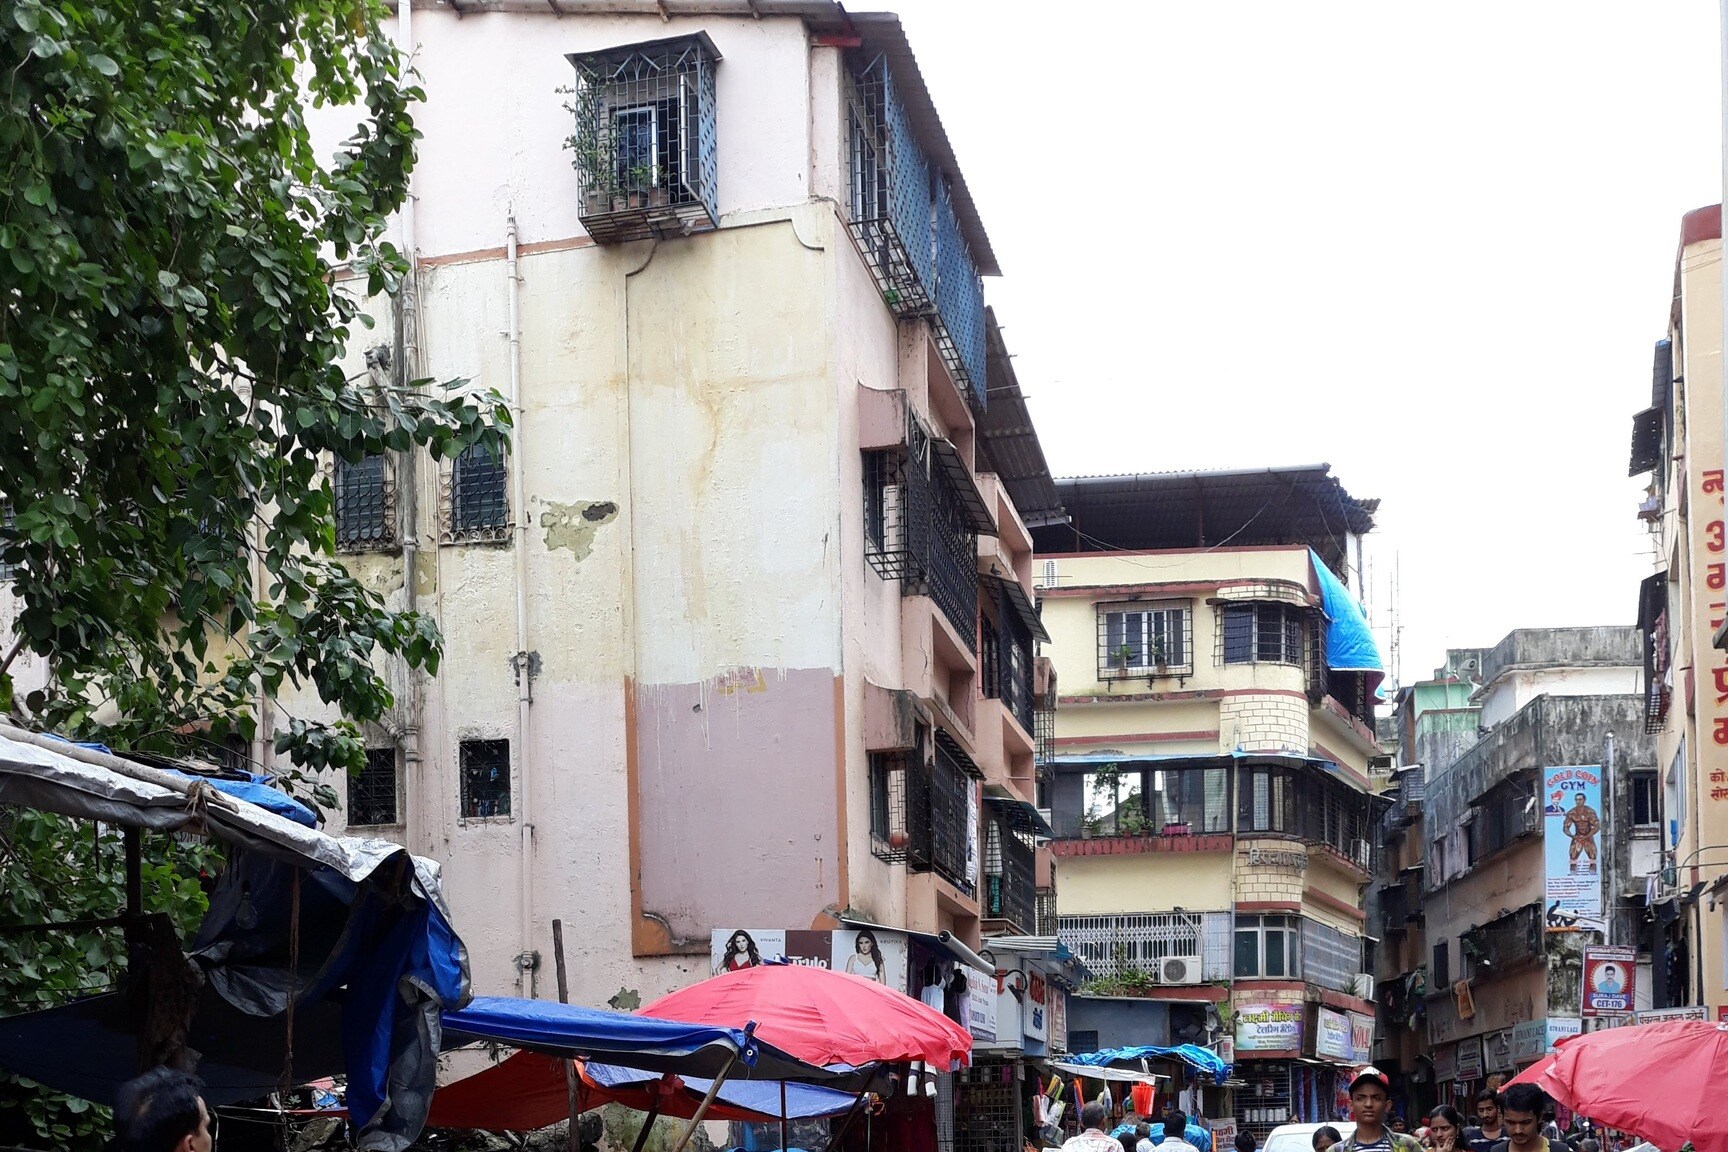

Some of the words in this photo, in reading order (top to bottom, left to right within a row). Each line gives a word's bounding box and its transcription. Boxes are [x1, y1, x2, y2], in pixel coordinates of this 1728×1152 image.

[1547, 769, 1573, 788] GOLD
[1560, 781, 1586, 790] GYM
[1596, 1000, 1623, 1008] CET-176
